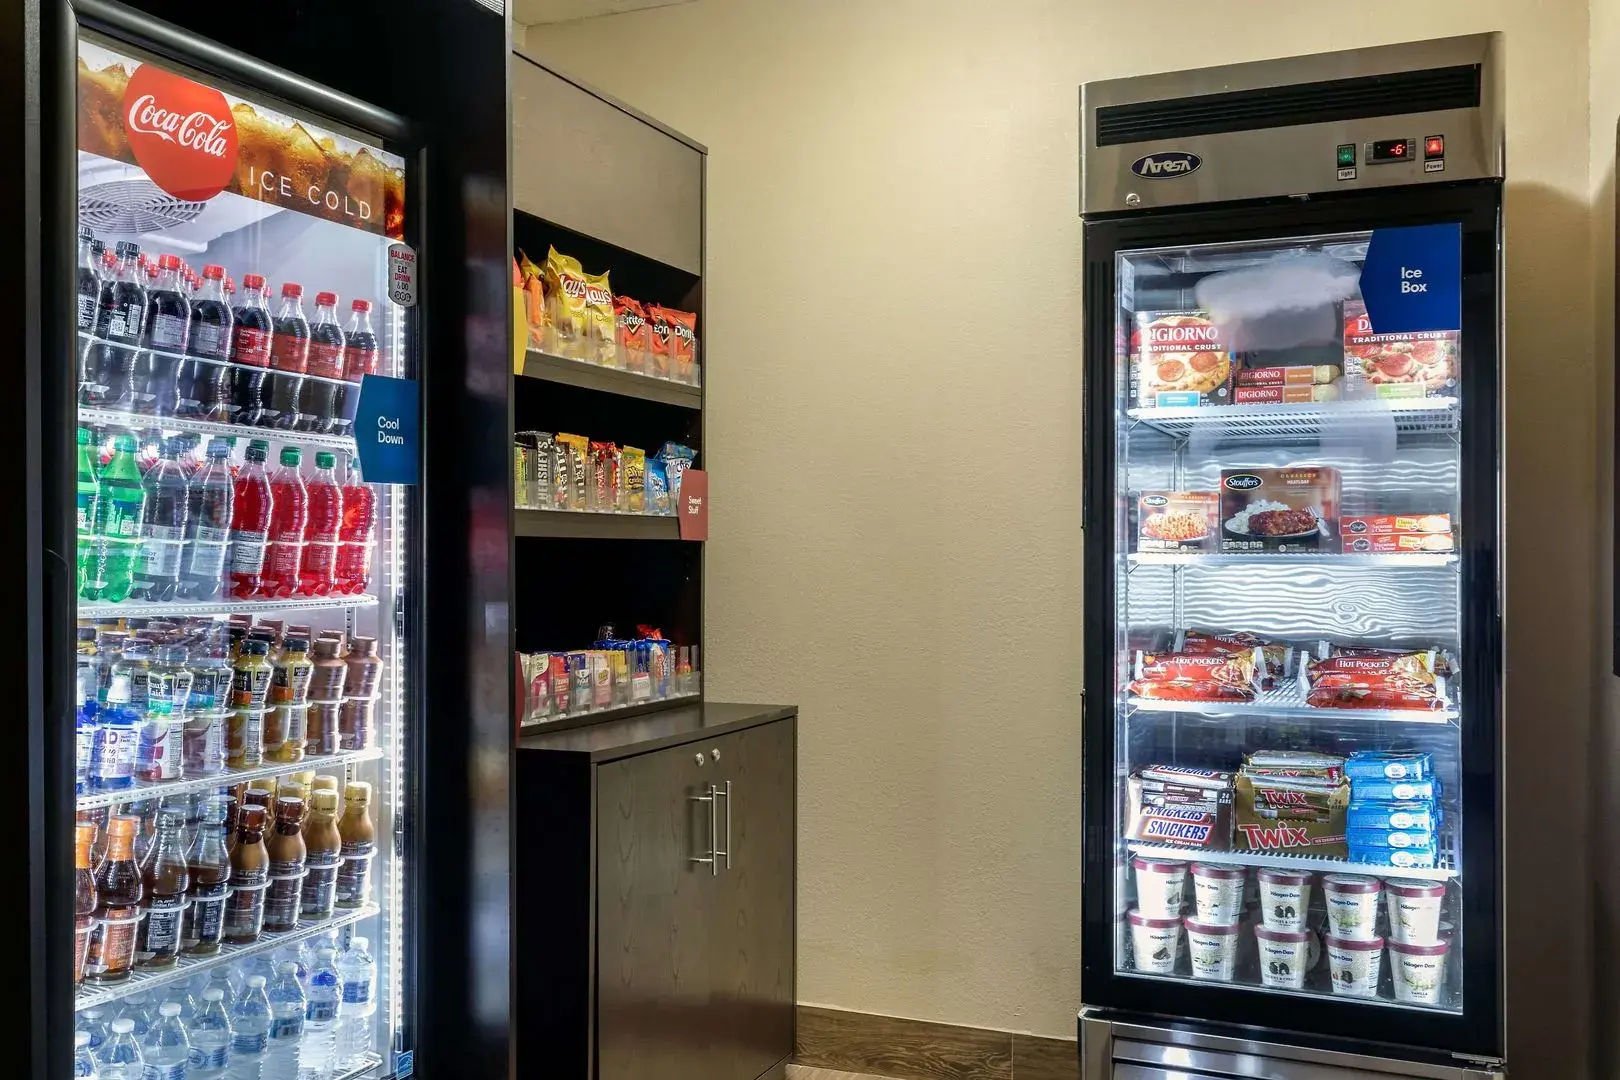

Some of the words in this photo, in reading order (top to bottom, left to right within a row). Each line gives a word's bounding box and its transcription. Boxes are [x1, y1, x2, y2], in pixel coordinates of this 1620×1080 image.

[129, 95, 232, 157] Coca-Cola
[250, 166, 292, 198] ICE
[308, 185, 371, 220] COLD
[391, 250, 415, 262] BALANCE
[397, 265, 408, 274] EAT
[1401, 266, 1423, 279] Ice
[394, 273, 411, 283] DRINK
[1401, 281, 1428, 293] Box
[1352, 334, 1415, 344] TRADITIONAL
[1417, 332, 1447, 340] CRUST
[1137, 344, 1192, 352] TADITIONAL
[1238, 389, 1278, 400] DIGIORNO
[377, 416, 400, 430] Cool
[377, 430, 404, 445] Down
[1228, 477, 1259, 488] Stouffer's
[688, 505, 699, 515] Stuff
[1175, 655, 1191, 664] HOT
[1191, 656, 1225, 665] POCKETS
[1339, 660, 1354, 668] HOT
[1355, 659, 1390, 668] POCKETS
[1148, 820, 1209, 841] SNICKERS
